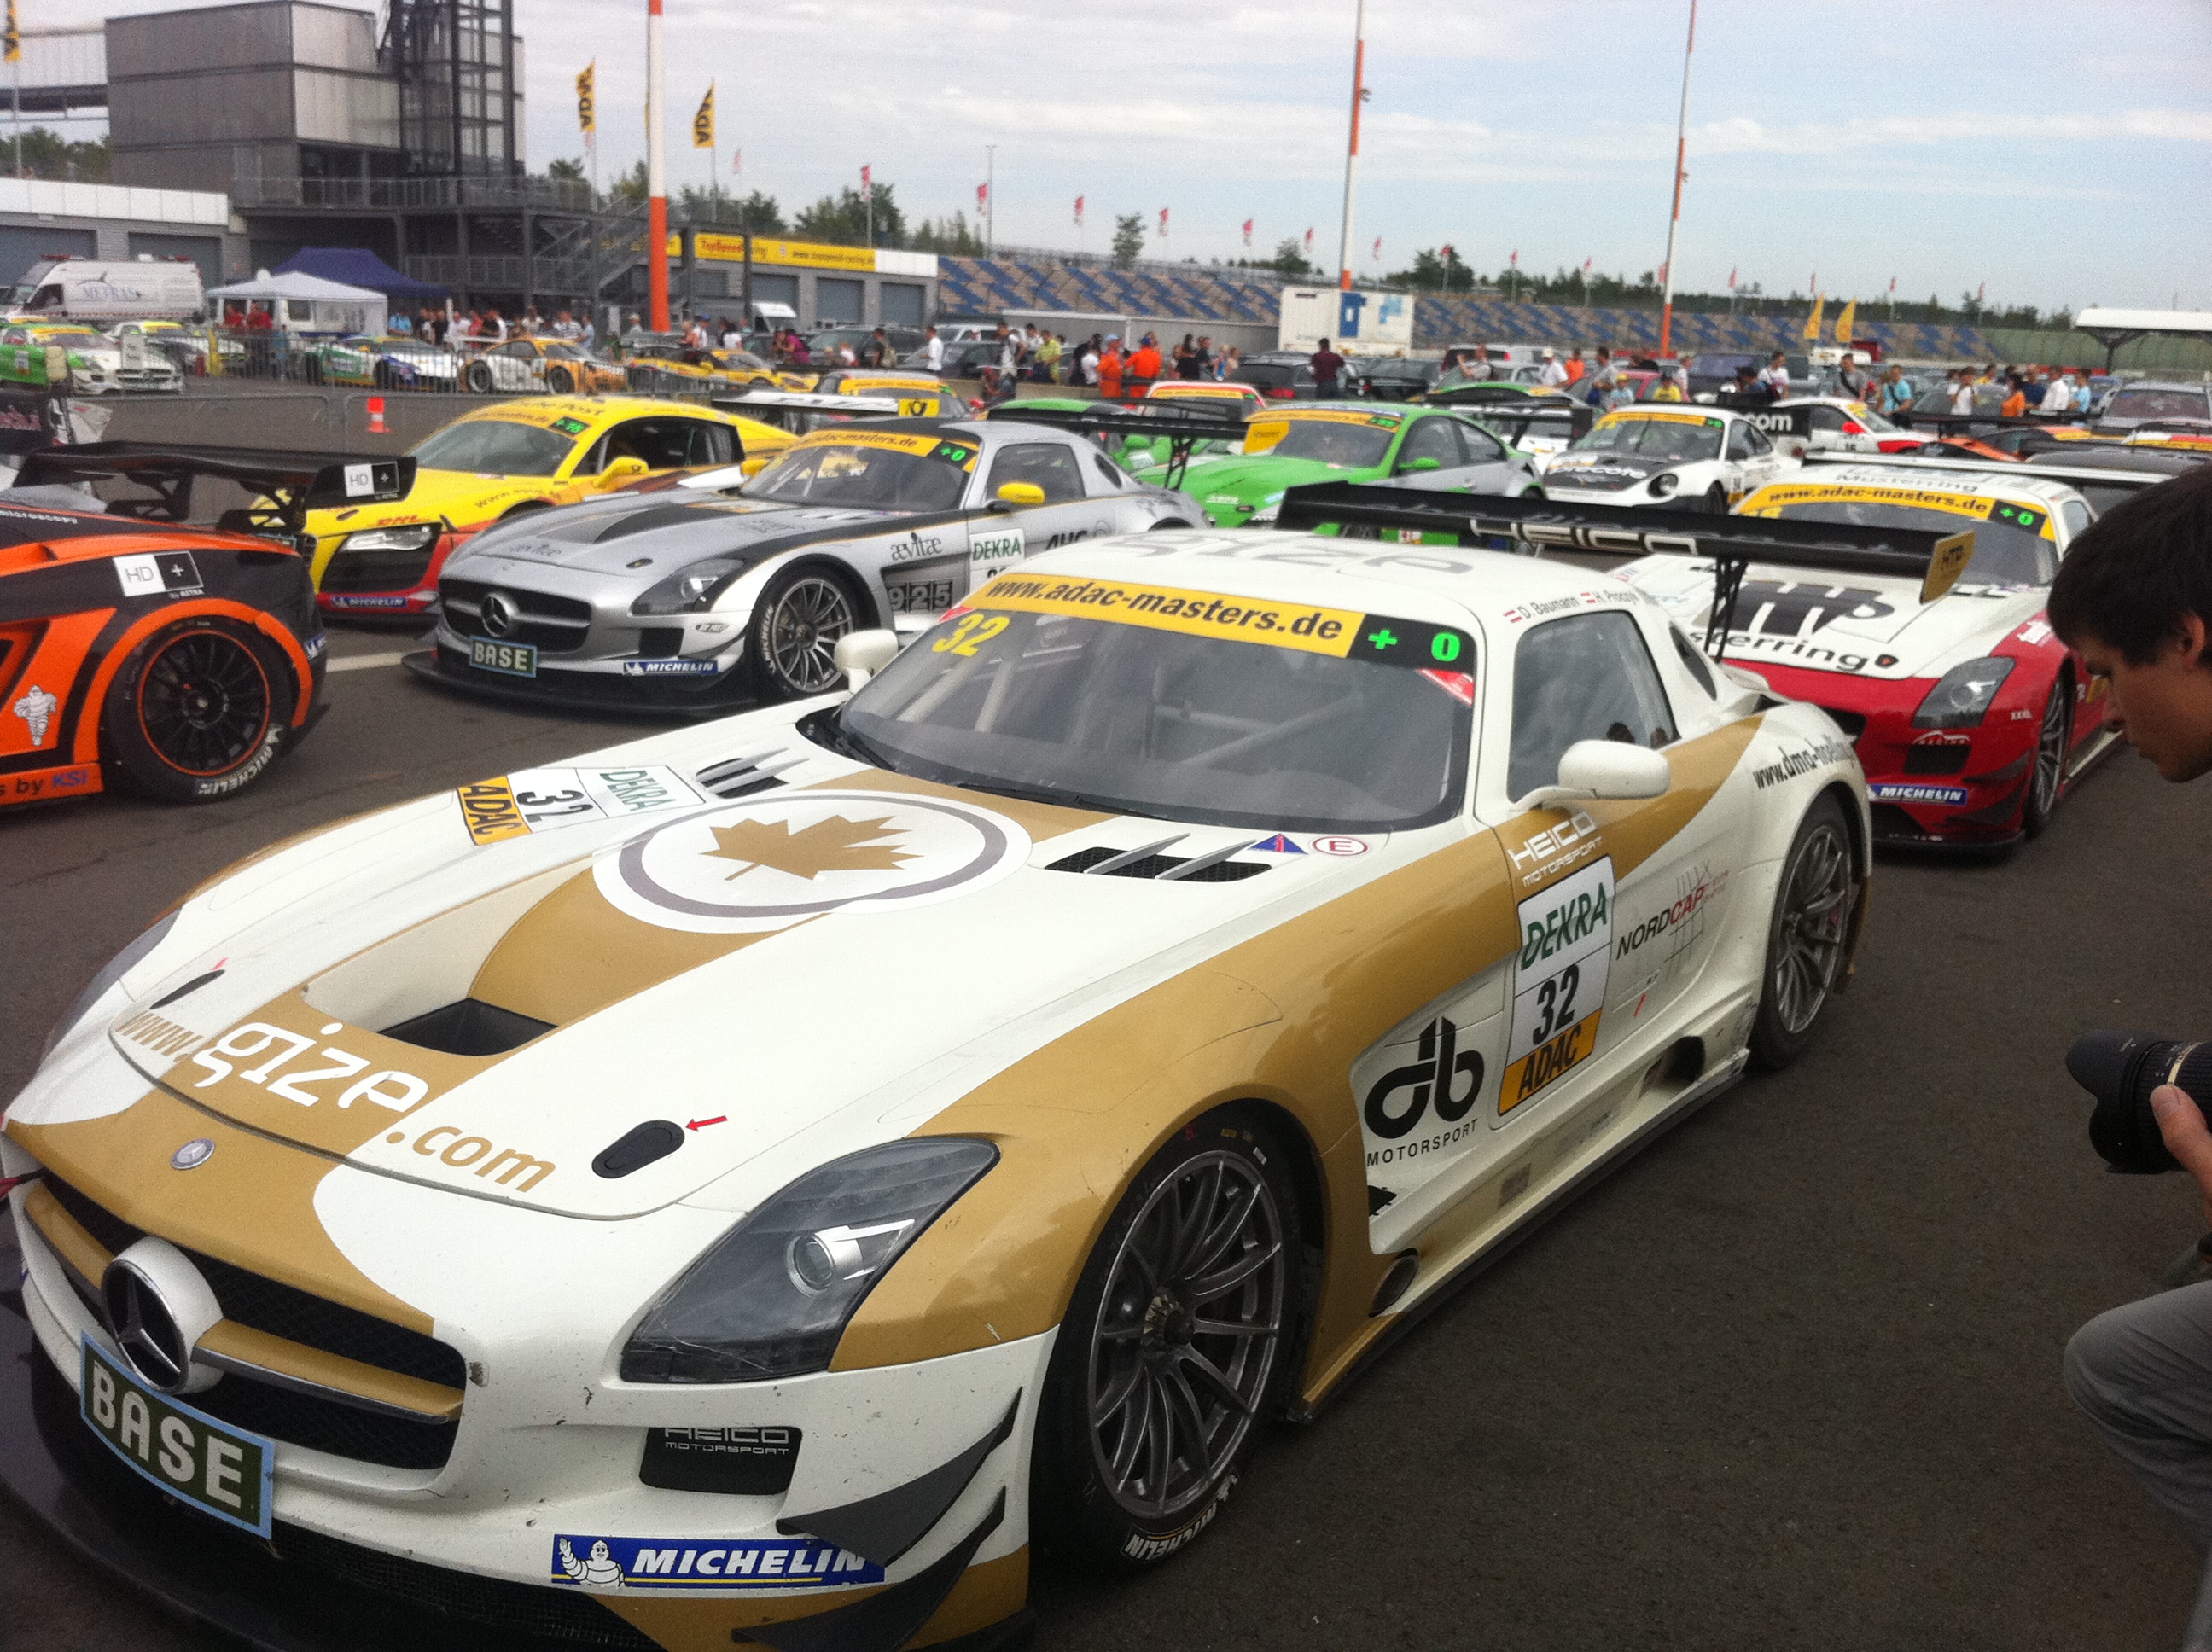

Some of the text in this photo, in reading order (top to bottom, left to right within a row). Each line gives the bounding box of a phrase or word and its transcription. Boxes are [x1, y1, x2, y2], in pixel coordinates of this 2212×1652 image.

[1768, 485, 1988, 513] www.adac-masters.de
[377, 515, 419, 526] DHL
[971, 537, 1022, 561] DEKRA
[125, 567, 155, 584] HD
[887, 581, 953, 610] 925
[985, 580, 1342, 641] www.adac-masters.de
[1530, 596, 1580, 616] Baumann
[932, 612, 1010, 658] 32
[474, 642, 528, 672] BASE
[646, 660, 714, 672] MICHELIN
[15, 777, 43, 796] by
[599, 770, 677, 811] DEKRA
[1880, 787, 1962, 801] MICHELIN
[463, 784, 524, 836] ADAC
[516, 789, 594, 823] 32
[1507, 810, 1598, 870] HEICO
[1522, 835, 1604, 887] MOTORSPORT
[1520, 881, 1608, 972] DEKRA
[1615, 886, 1705, 961] NORDCAP
[1531, 963, 1580, 1046] 32
[1516, 1025, 1583, 1102] ADAC
[1366, 1119, 1479, 1168] MOTORSPORT
[92, 1359, 244, 1509] BASE
[663, 1427, 790, 1445] HEICO
[665, 1441, 790, 1456] MOTORSPORT
[1124, 1502, 1218, 1561] MICHELIN
[632, 1548, 865, 1575] MICHELIN
